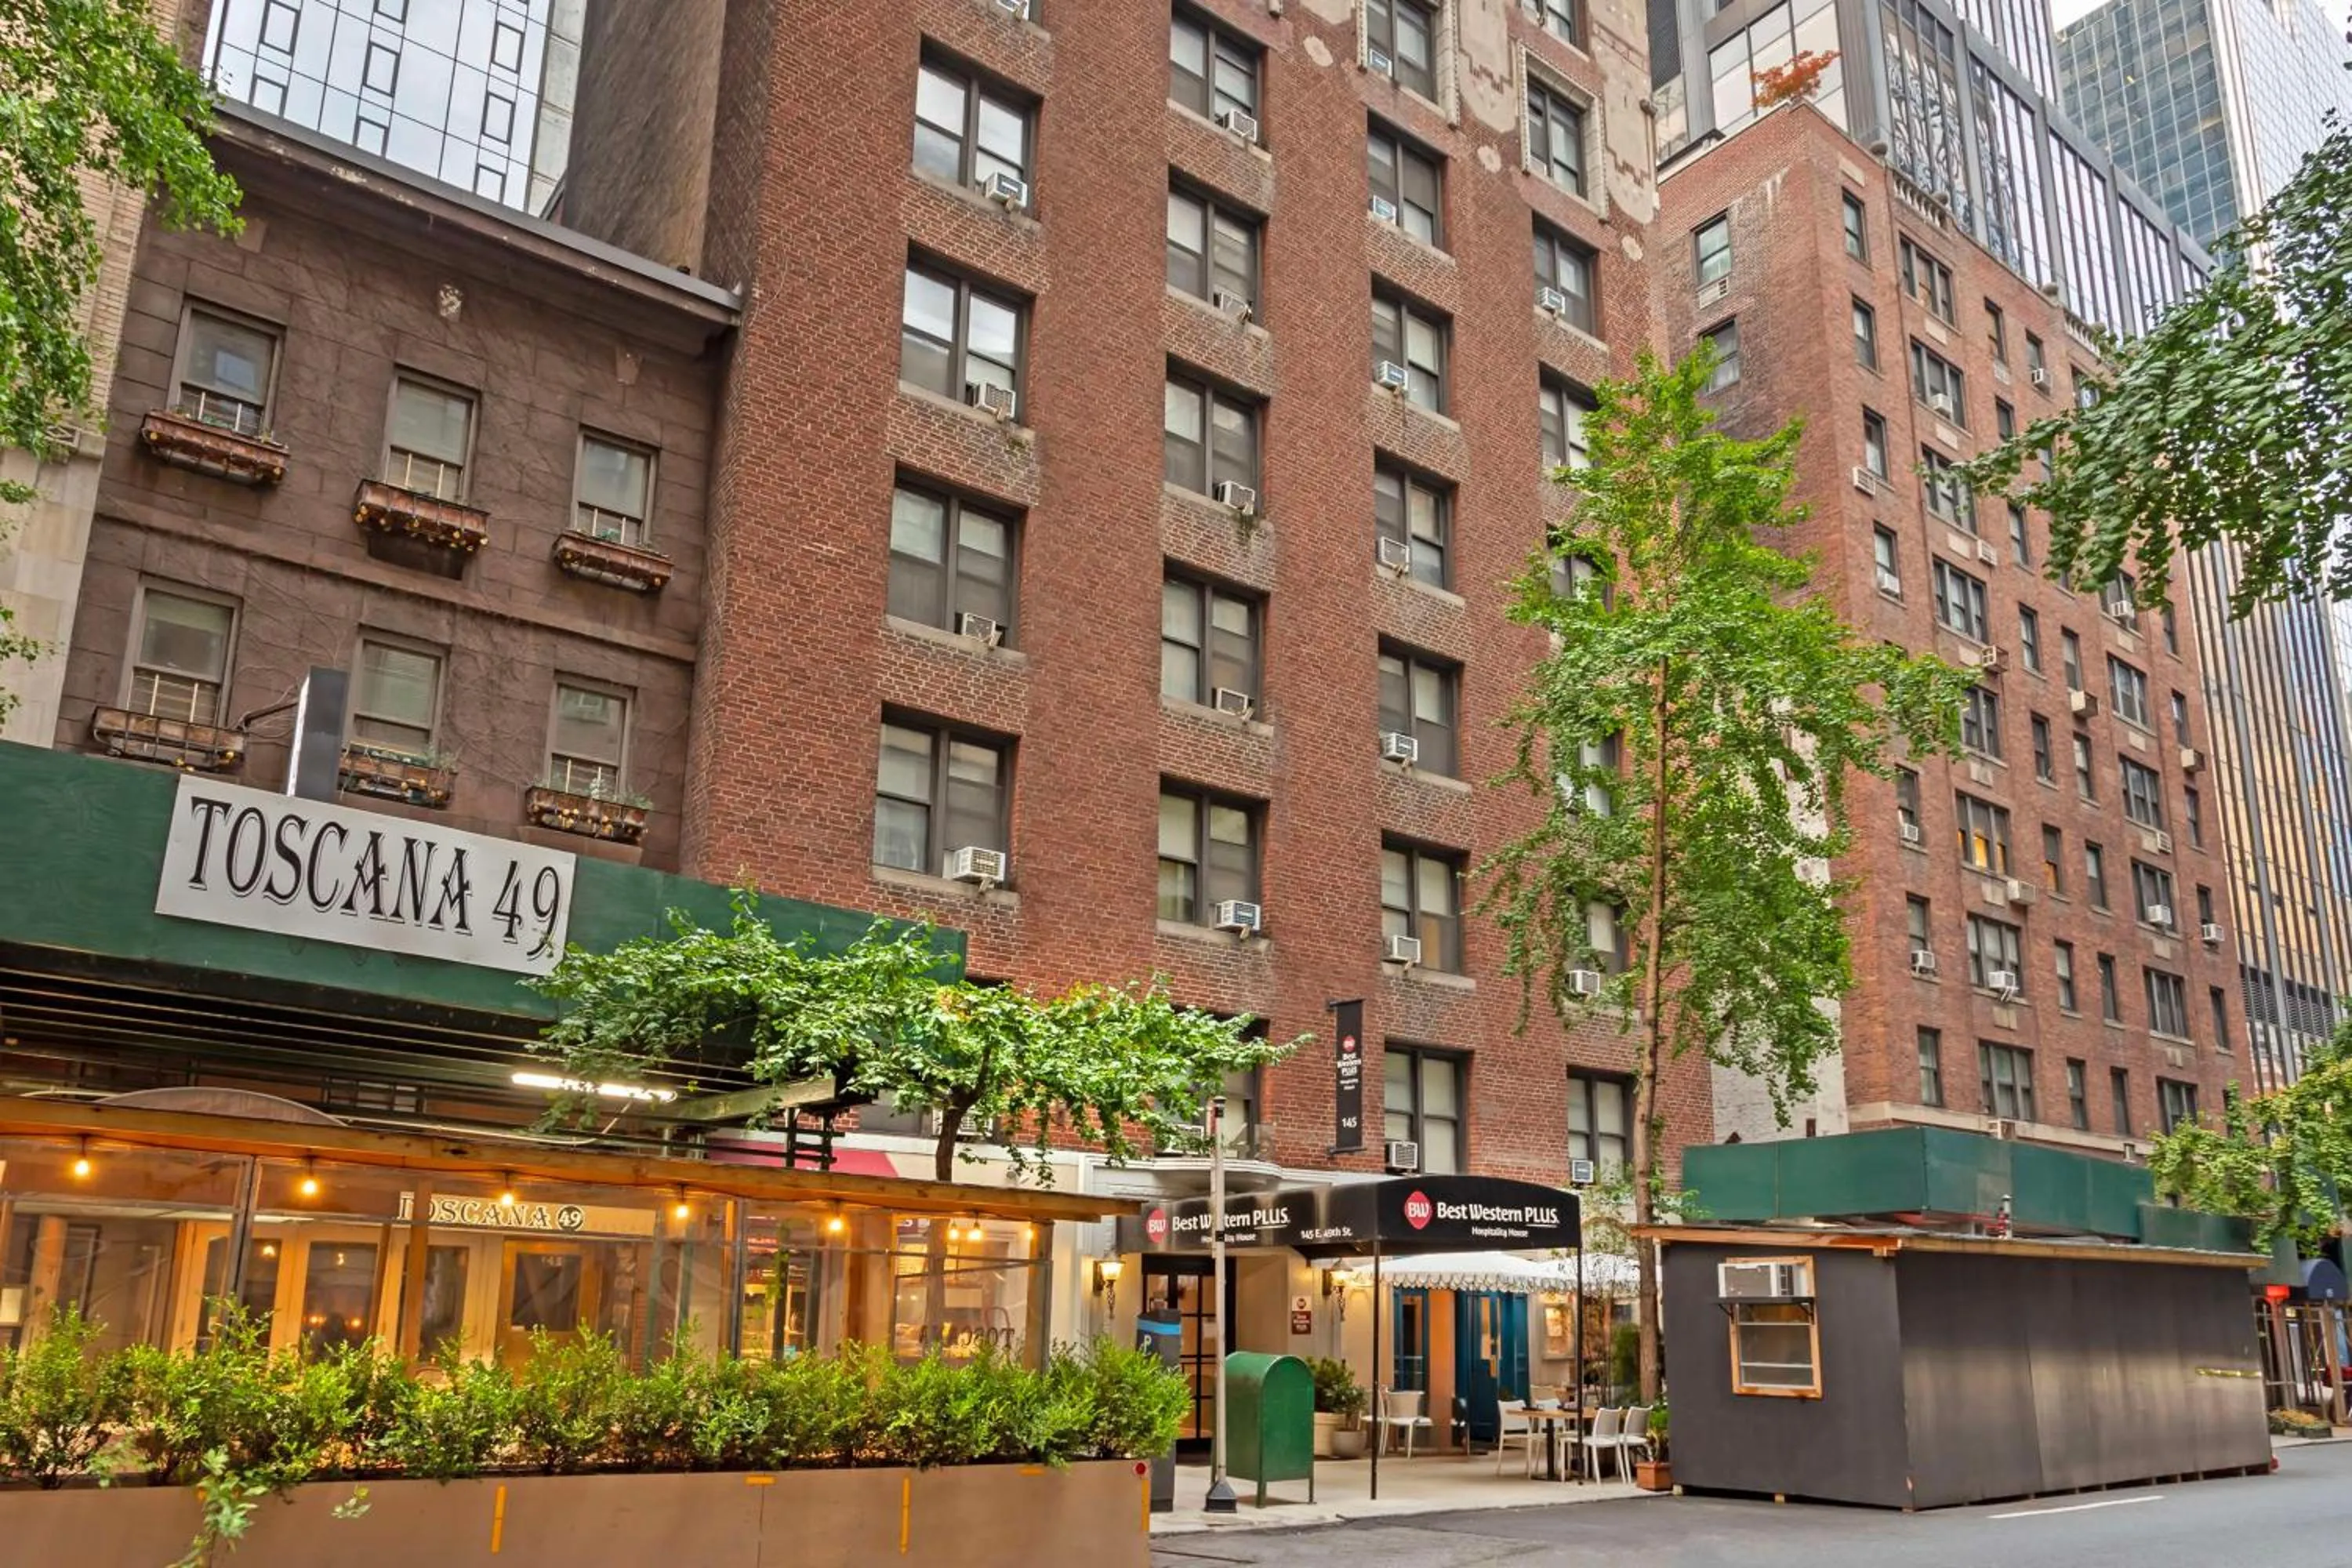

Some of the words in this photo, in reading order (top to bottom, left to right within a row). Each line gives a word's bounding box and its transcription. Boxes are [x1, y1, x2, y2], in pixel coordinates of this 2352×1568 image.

[187, 796, 474, 936] TOSCANA
[492, 860, 560, 961] 49
[1341, 1116, 1357, 1127] 145
[1408, 1202, 1429, 1218] BW
[1437, 1202, 1468, 1219] Best
[1468, 1203, 1523, 1222] Western
[558, 1210, 581, 1228] 49
[1149, 1219, 1166, 1232] BW
[1172, 1216, 1198, 1231] Best
[1199, 1214, 1250, 1230] Wtern
[1472, 1226, 1507, 1239] Hospitality
[1508, 1227, 1528, 1238] House
